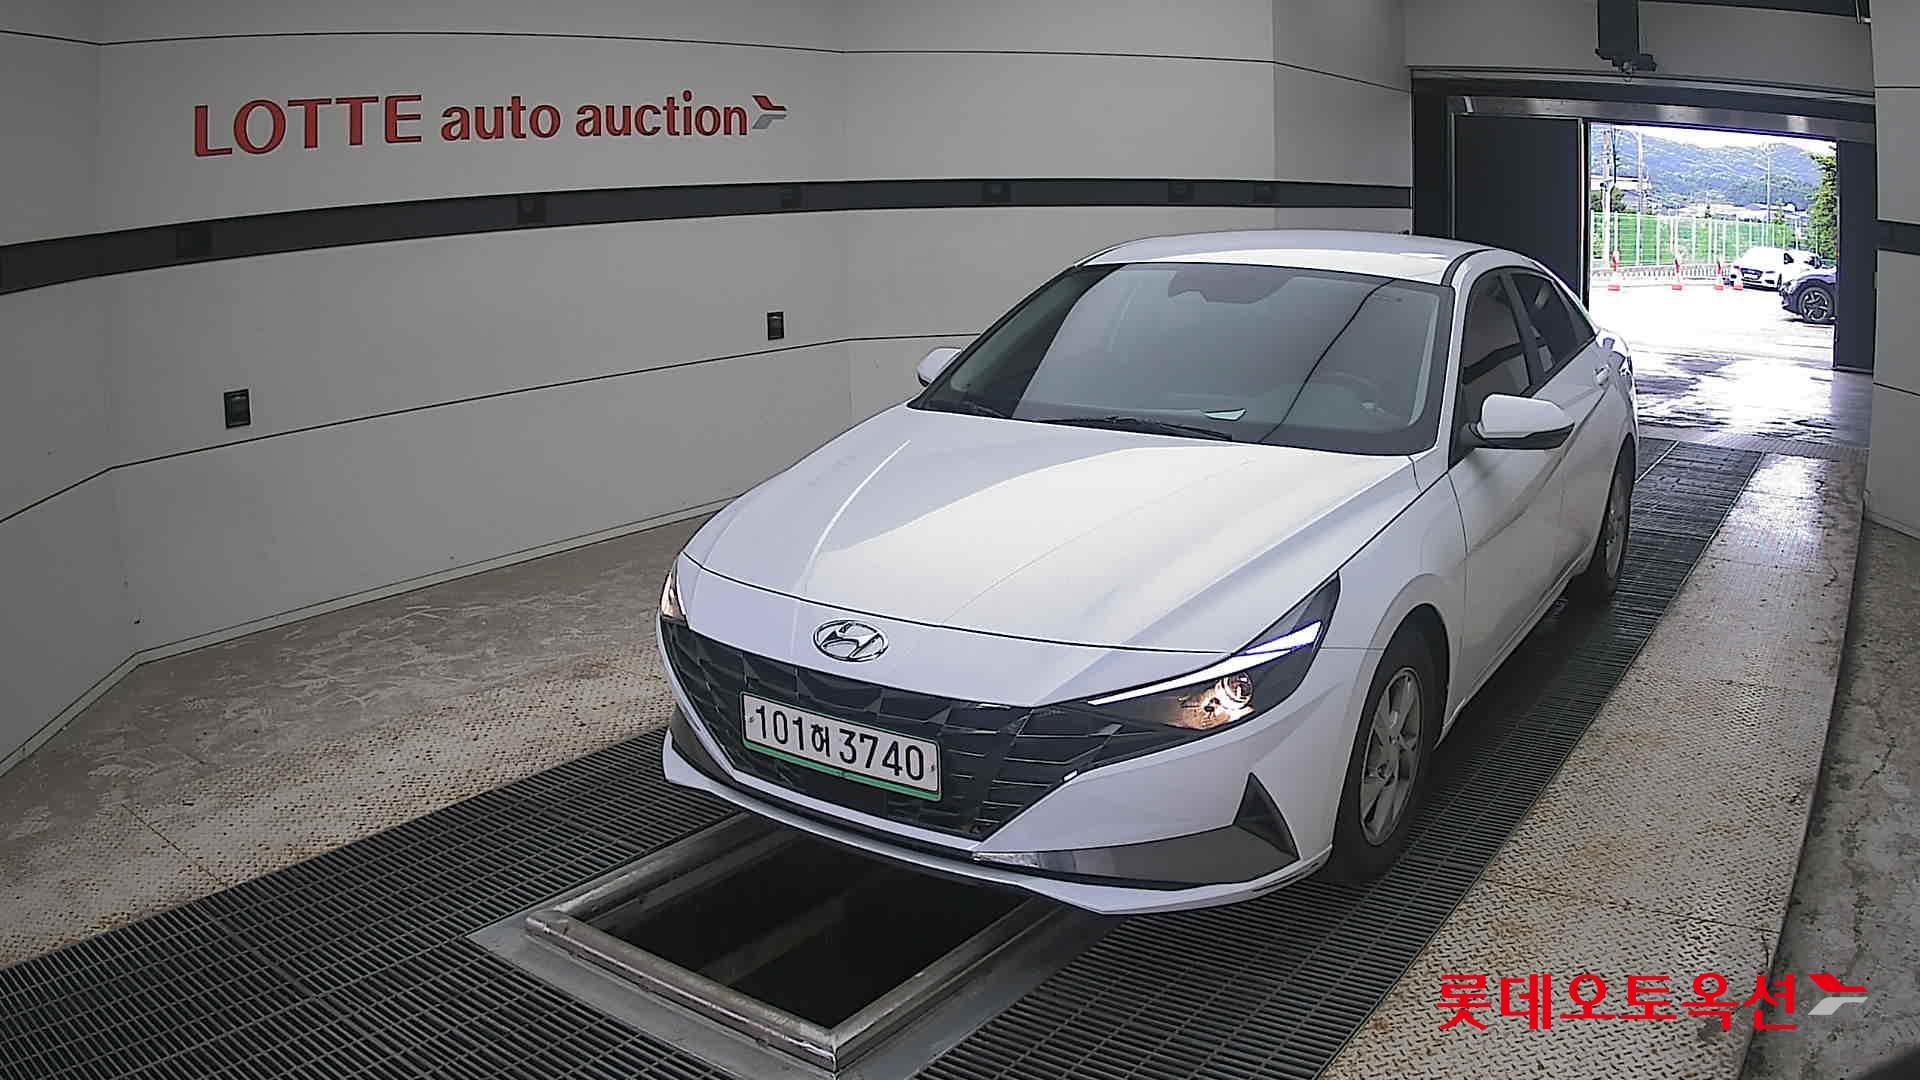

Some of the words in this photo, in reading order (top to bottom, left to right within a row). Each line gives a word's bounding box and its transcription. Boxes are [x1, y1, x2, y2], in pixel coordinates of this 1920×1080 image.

[193, 95, 422, 157] LOTTE
[440, 96, 561, 141] auto
[575, 90, 748, 137] auction
[839, 728, 924, 781] 3740
